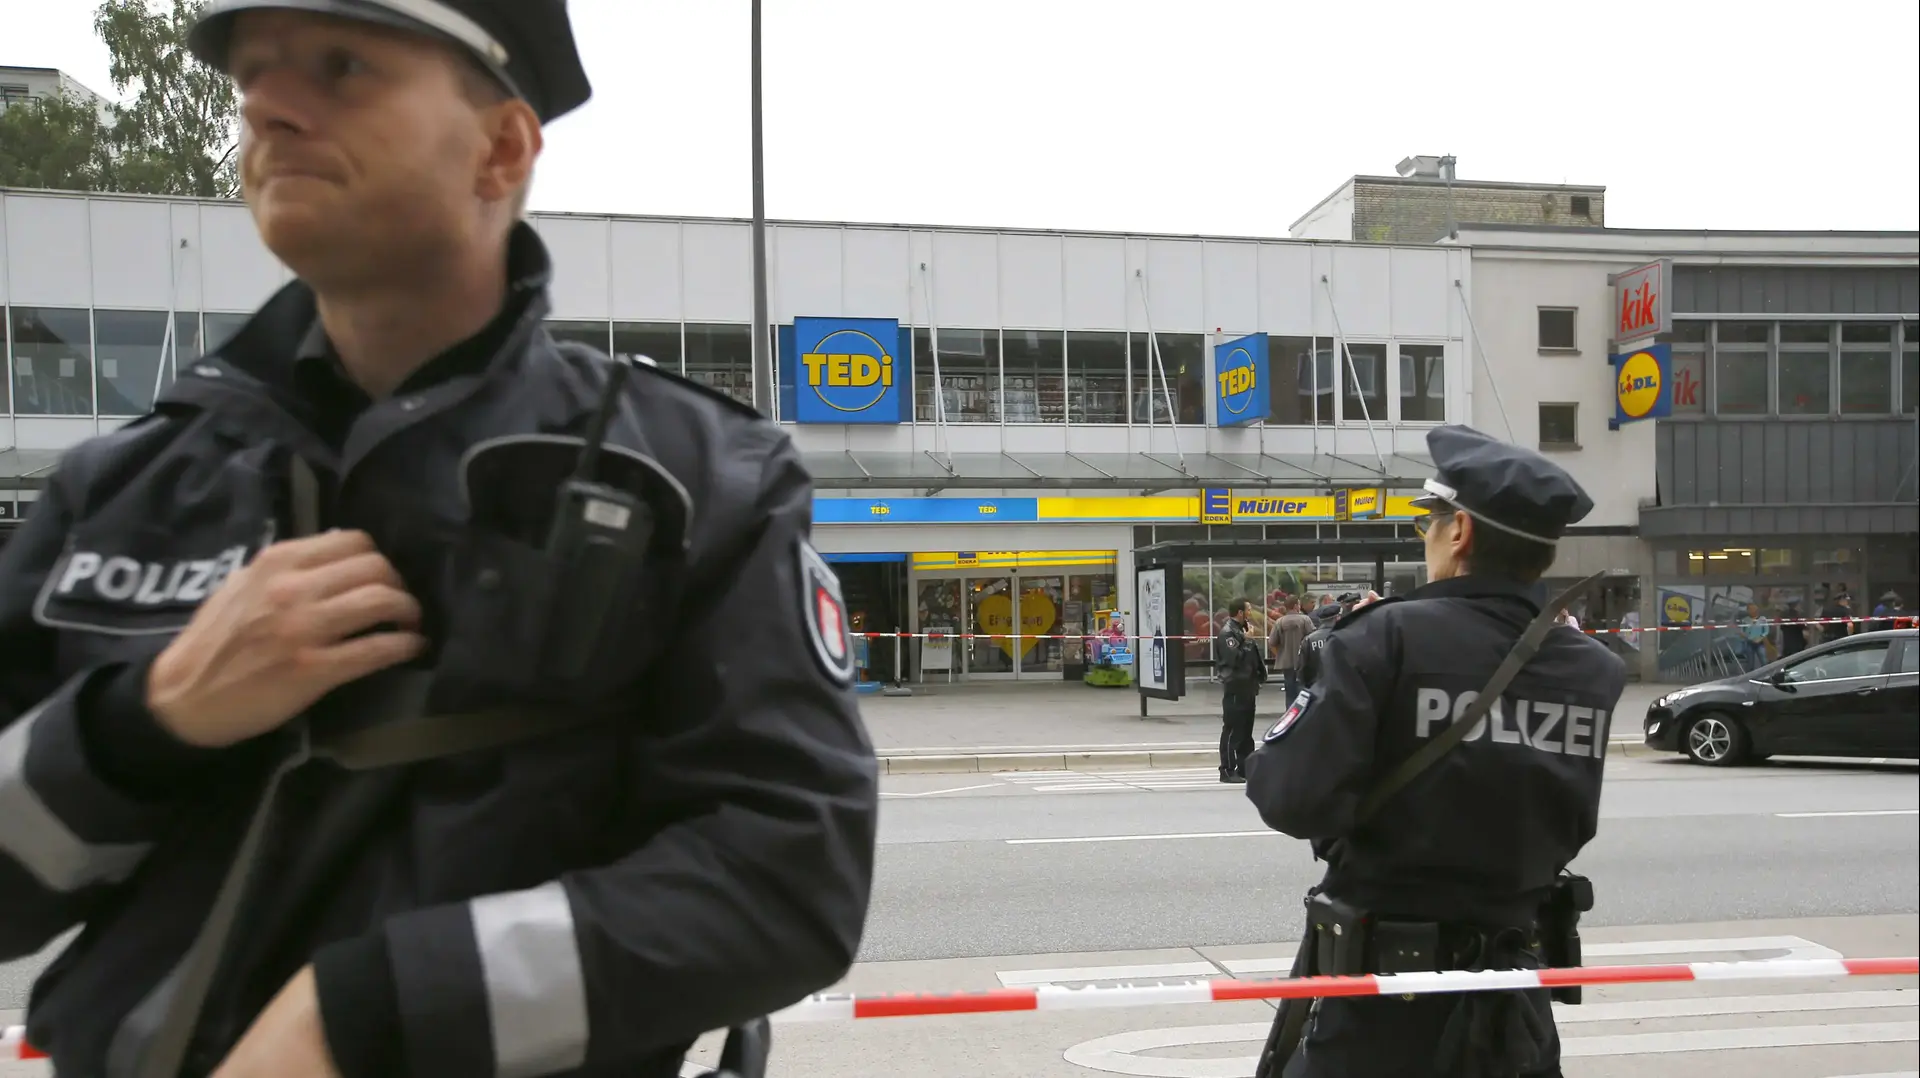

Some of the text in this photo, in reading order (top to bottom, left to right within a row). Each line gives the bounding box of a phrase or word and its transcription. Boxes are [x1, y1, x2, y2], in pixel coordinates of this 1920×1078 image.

[1621, 274, 1656, 333] kik
[802, 353, 893, 387] TEDi
[1218, 363, 1255, 398] TEDi
[1672, 365, 1699, 405] ik
[870, 506, 890, 515] TEDi
[978, 506, 997, 514] TEDi
[1237, 499, 1307, 514] Müller
[1354, 496, 1375, 506] Müller
[1311, 639, 1326, 651] PO
[1416, 688, 1607, 759] POLIZEI
